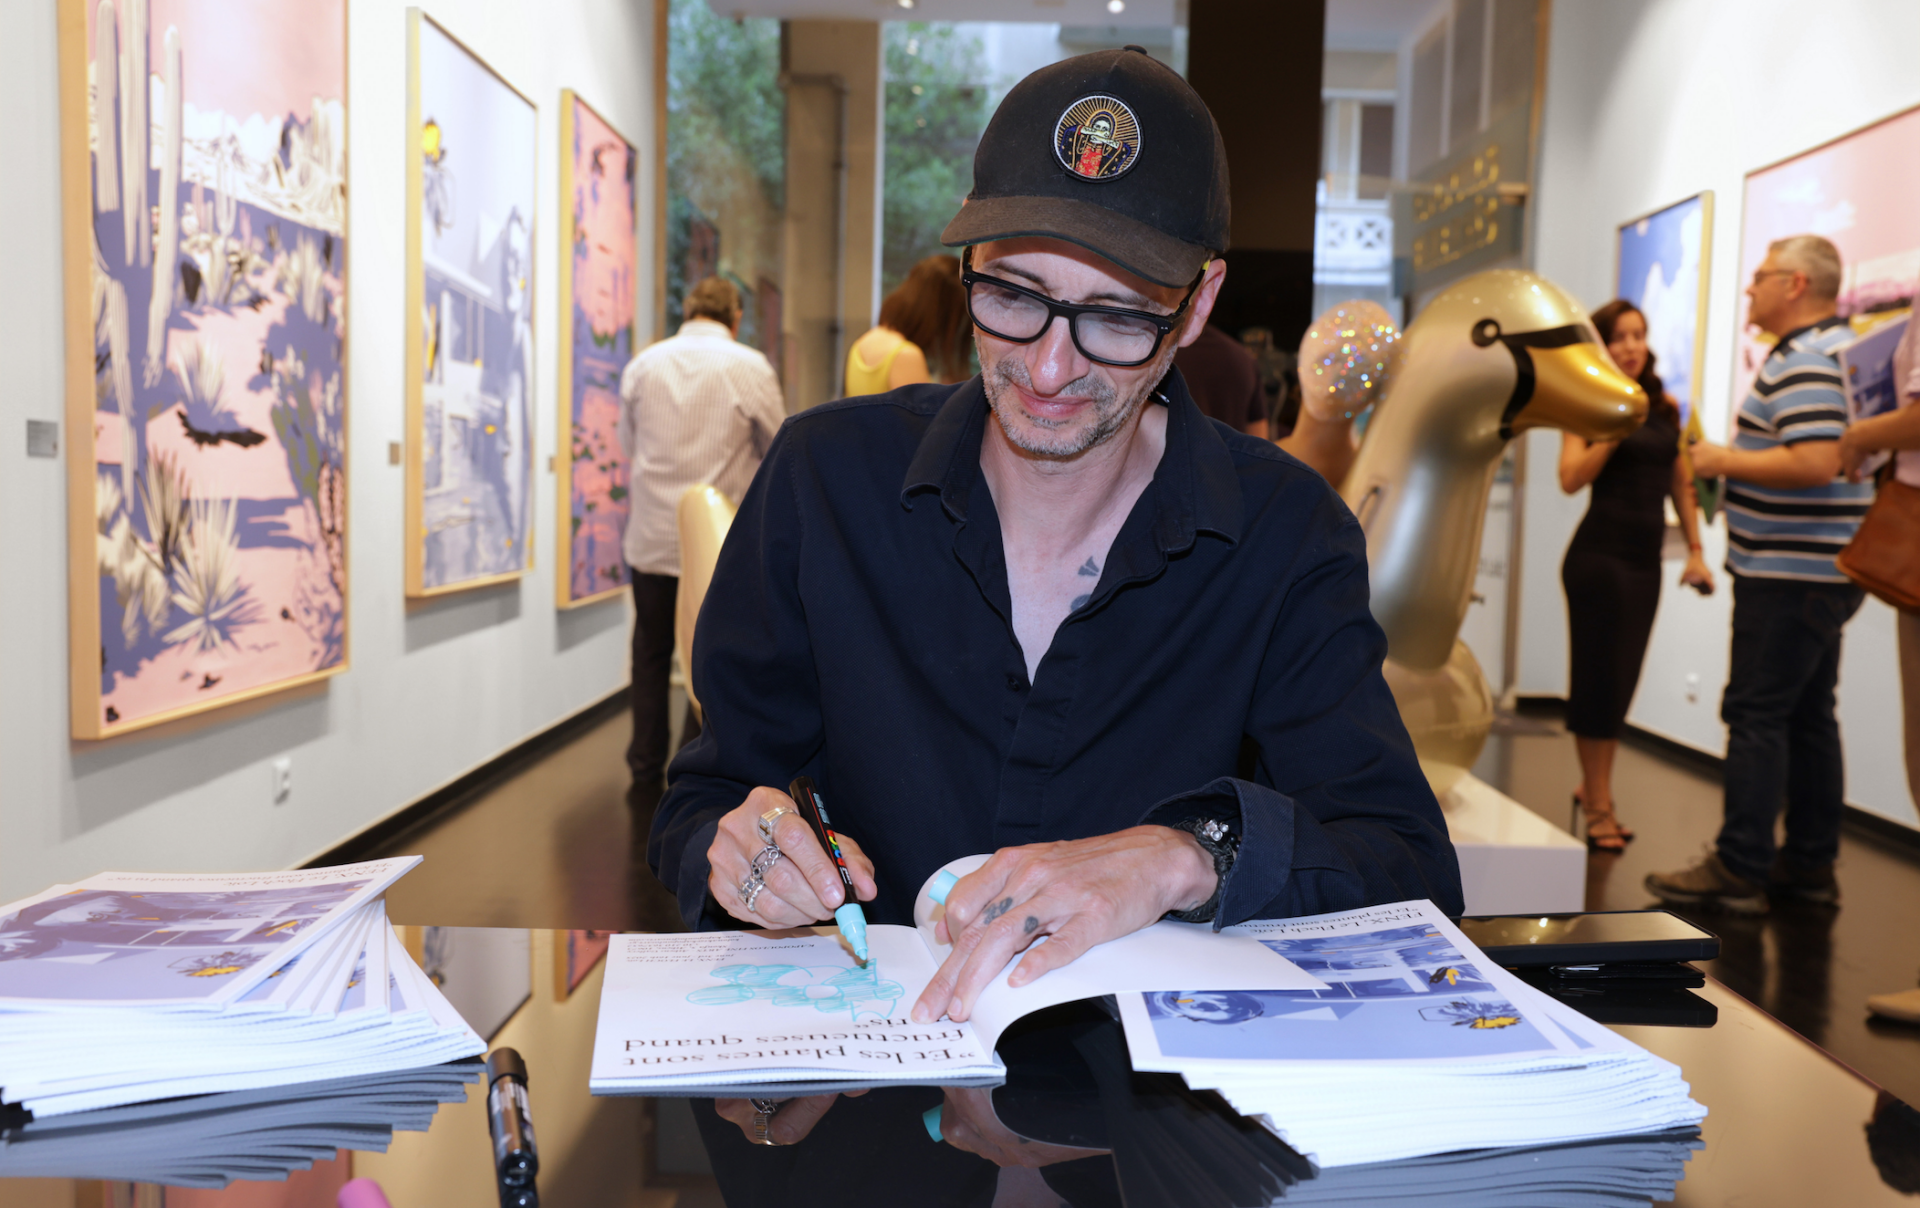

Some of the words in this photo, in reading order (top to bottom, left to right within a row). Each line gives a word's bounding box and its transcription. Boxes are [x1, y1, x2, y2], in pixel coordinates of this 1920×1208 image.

[1325, 912, 1371, 922] plantes
[1364, 911, 1424, 925] FENX,
[1290, 924, 1335, 934] Floch
[755, 1028, 965, 1043] fructueuses
[622, 1034, 744, 1052] quand
[622, 1053, 704, 1066] sont
[717, 1045, 848, 1060] plantes
[858, 1050, 905, 1064] les
